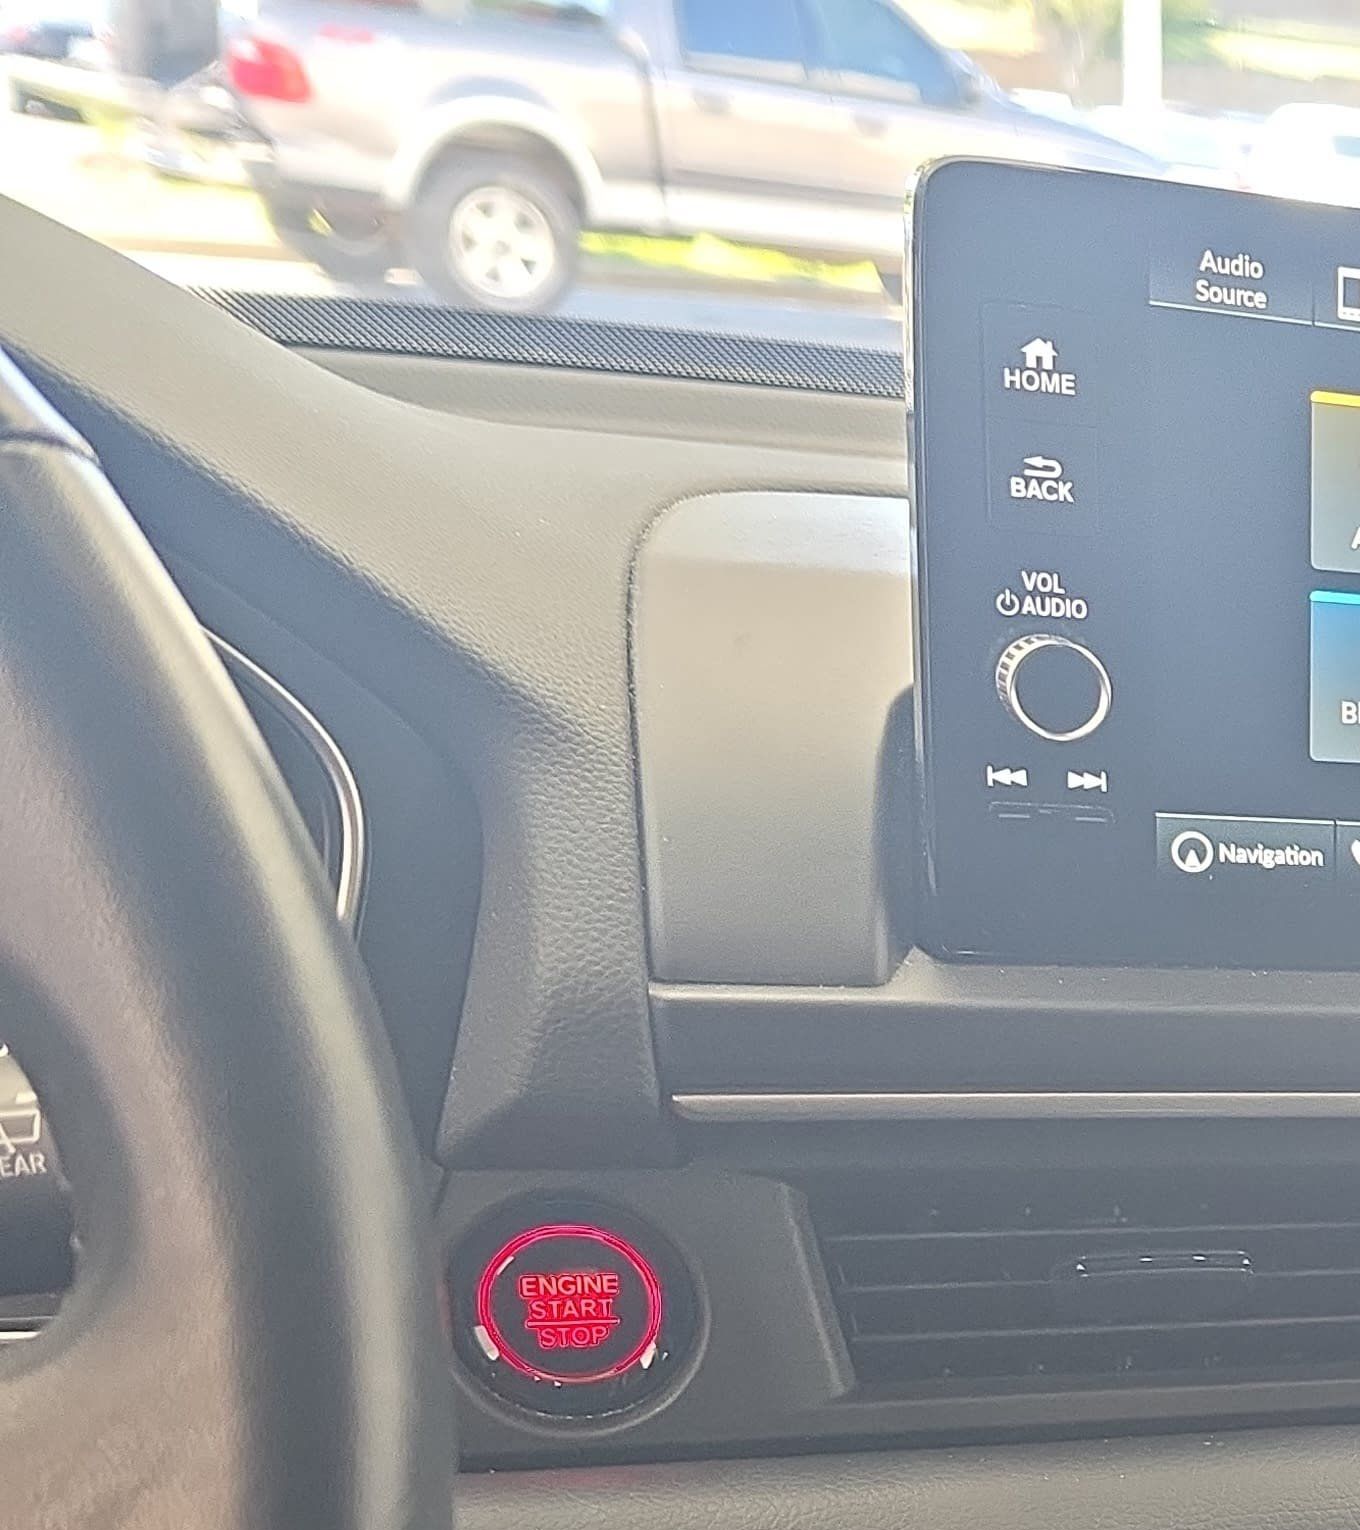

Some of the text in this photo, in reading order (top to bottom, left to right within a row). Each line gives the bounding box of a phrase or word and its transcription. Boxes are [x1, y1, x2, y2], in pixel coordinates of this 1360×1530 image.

[1199, 249, 1263, 281] Audio
[1195, 278, 1267, 310] Source
[1003, 367, 1077, 396] HOME
[1010, 476, 1075, 503] BACK
[1021, 570, 1066, 594] VOL
[1021, 594, 1088, 619] AUDIO
[1218, 843, 1324, 869] Navigation
[0, 1151, 48, 1177] EAR
[518, 1272, 619, 1298] ENGINE
[530, 1298, 612, 1321] START
[539, 1324, 609, 1349] STOP
